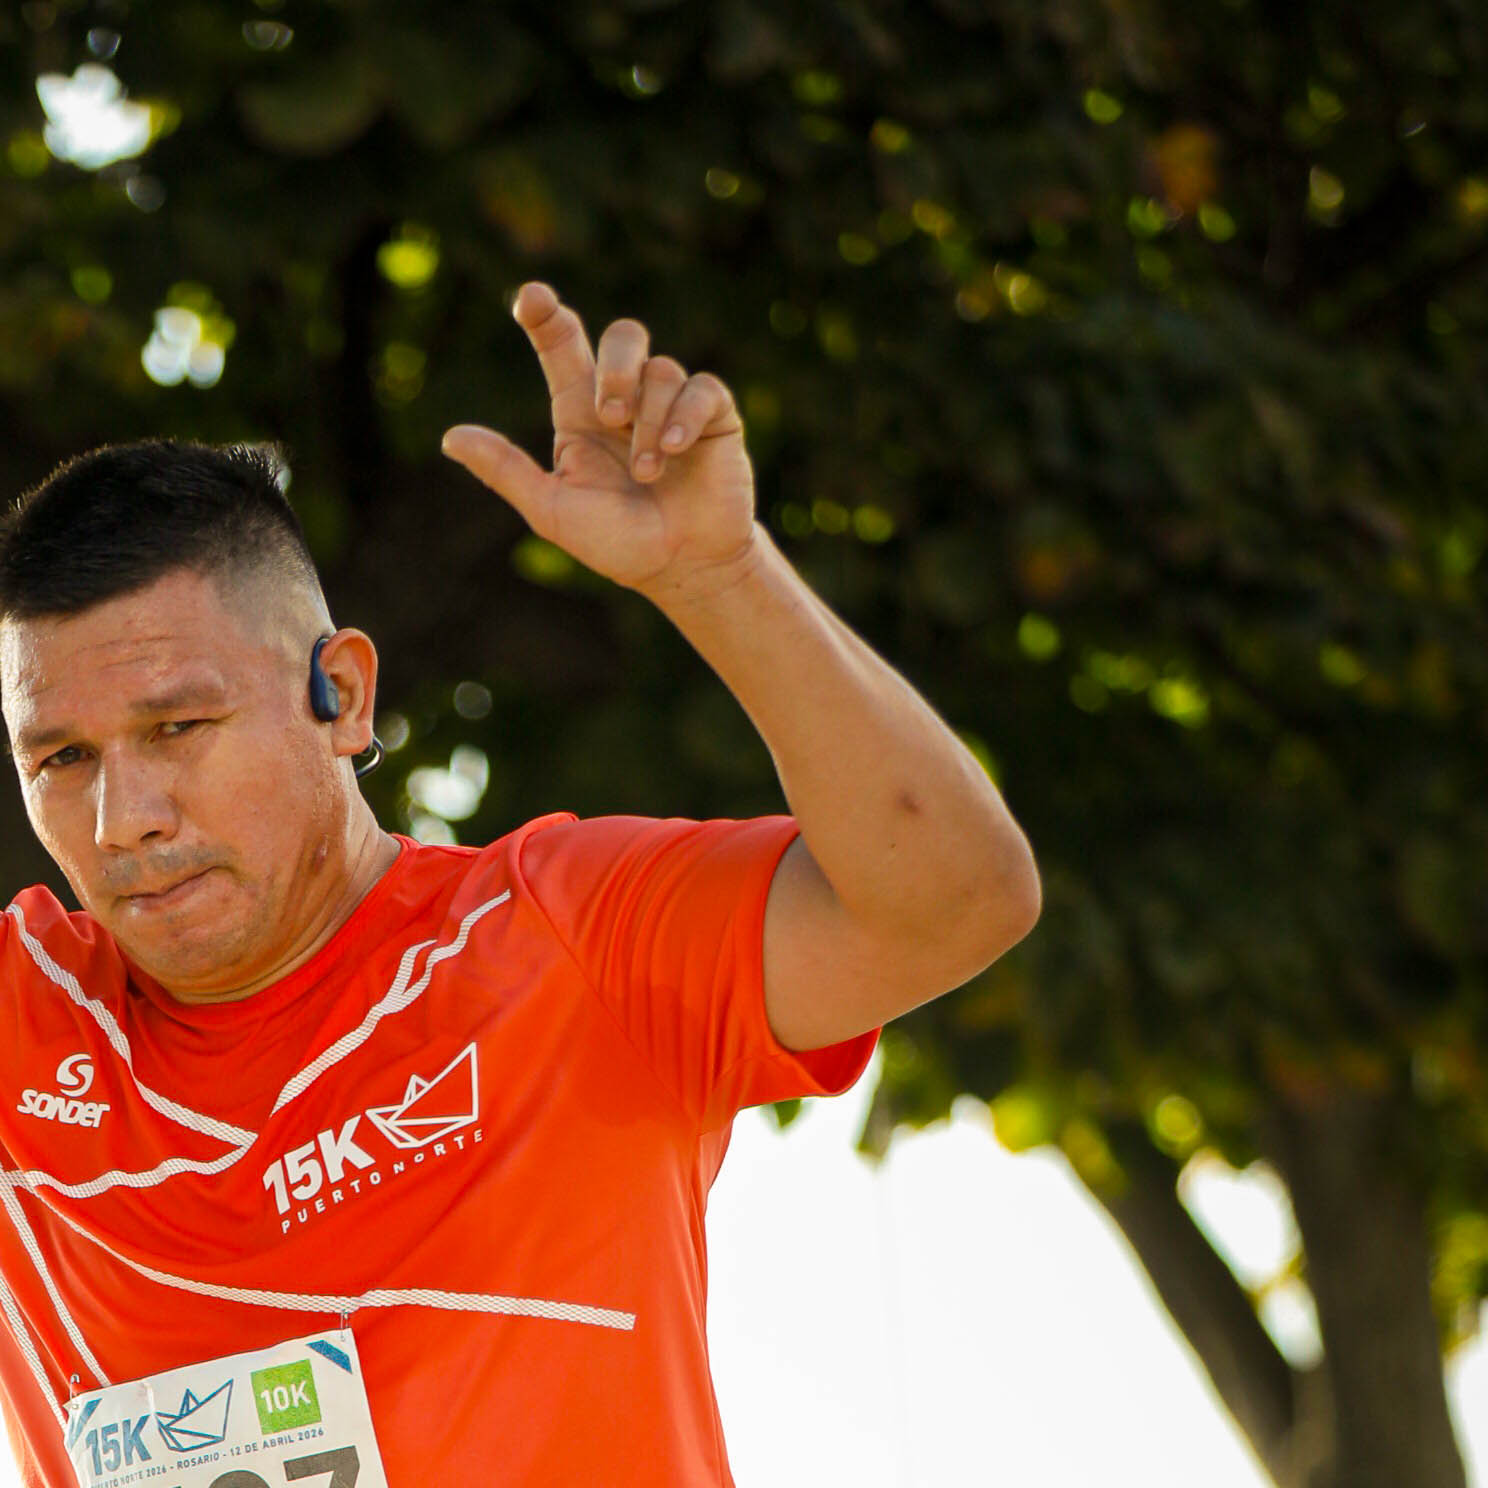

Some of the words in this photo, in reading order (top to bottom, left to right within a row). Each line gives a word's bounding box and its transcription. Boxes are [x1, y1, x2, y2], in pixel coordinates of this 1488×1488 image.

[262, 1115, 376, 1215] 15K
[281, 1172, 381, 1234] PUERTO
[393, 1129, 483, 1174] NORTE
[260, 1380, 311, 1414] 10K
[85, 1413, 152, 1476] 15K
[177, 1451, 220, 1470] ROSARIO
[230, 1446, 242, 1456] 12
[244, 1442, 259, 1453] DE
[262, 1433, 295, 1449] ABRIL
[297, 1427, 324, 1441] 2026
